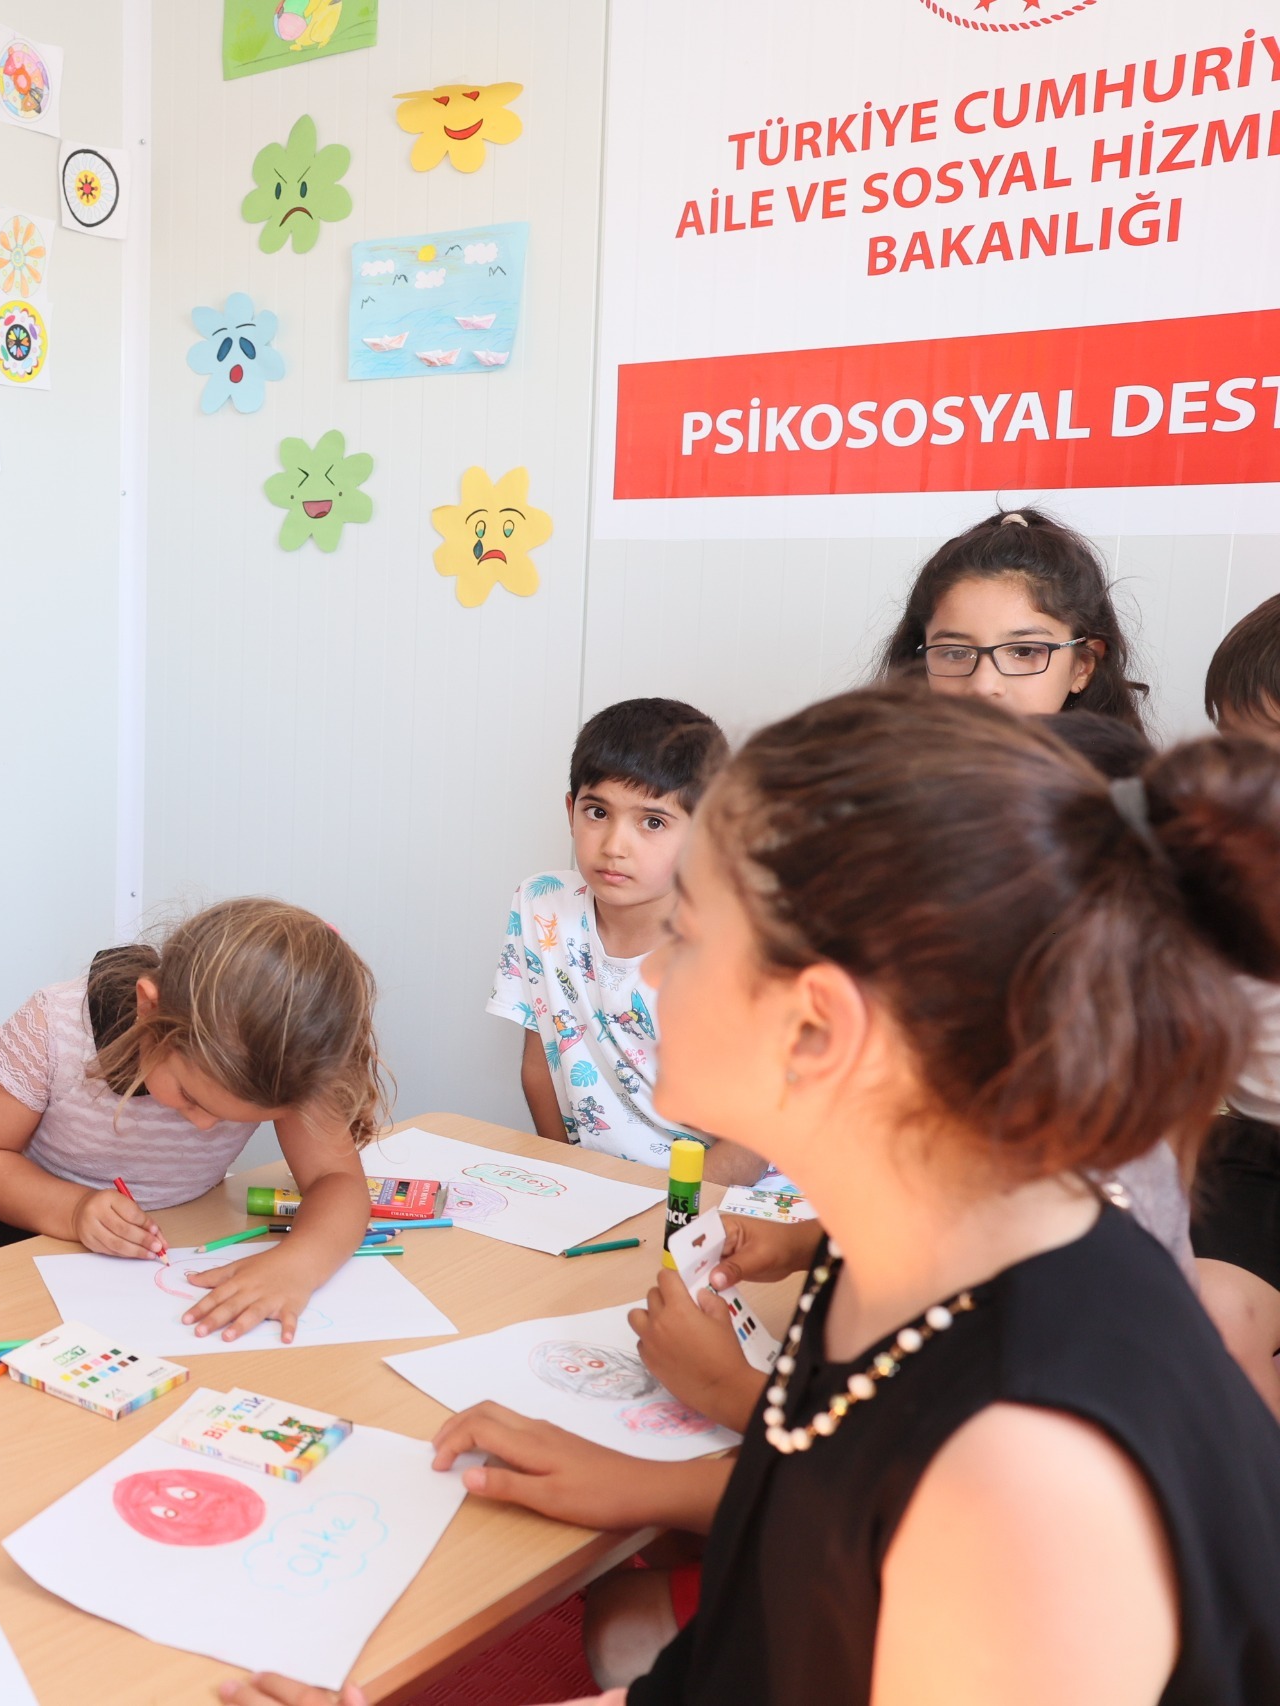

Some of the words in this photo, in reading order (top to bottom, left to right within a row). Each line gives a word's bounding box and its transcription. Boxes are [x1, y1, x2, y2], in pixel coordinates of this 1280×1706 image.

[727, 99, 939, 171] TÜRKİYE
[674, 187, 775, 239] AİLE
[786, 178, 848, 221] VE
[862, 146, 1073, 215] SOSYAL
[866, 190, 1184, 277] BAKANLIĞI
[680, 389, 1091, 457] PSİKOSOSYAL
